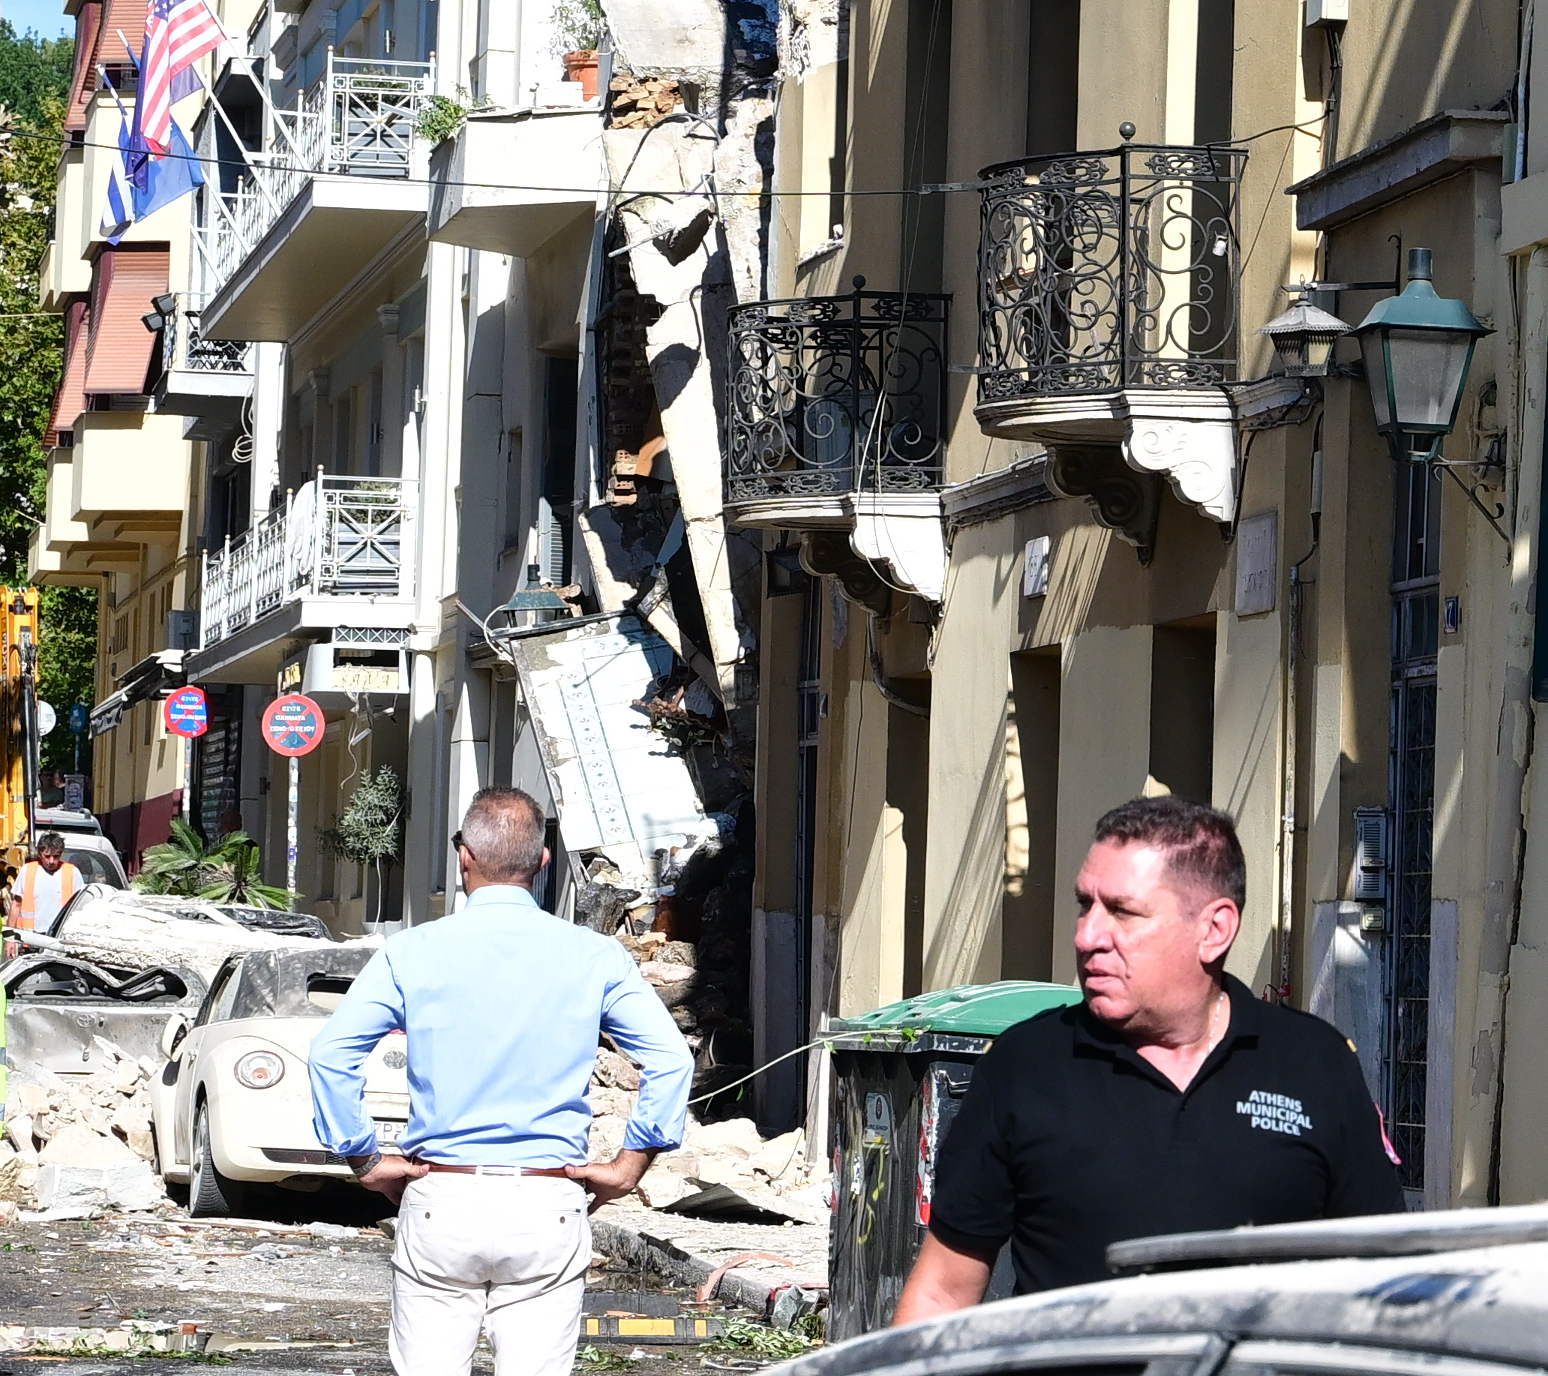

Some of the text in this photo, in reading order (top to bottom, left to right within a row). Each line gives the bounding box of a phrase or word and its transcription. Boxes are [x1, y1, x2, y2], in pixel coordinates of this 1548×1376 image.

[1249, 1090, 1302, 1113] ATHENS
[1236, 1101, 1313, 1130] MUNICIPAL
[1251, 1116, 1302, 1137] POLICE
